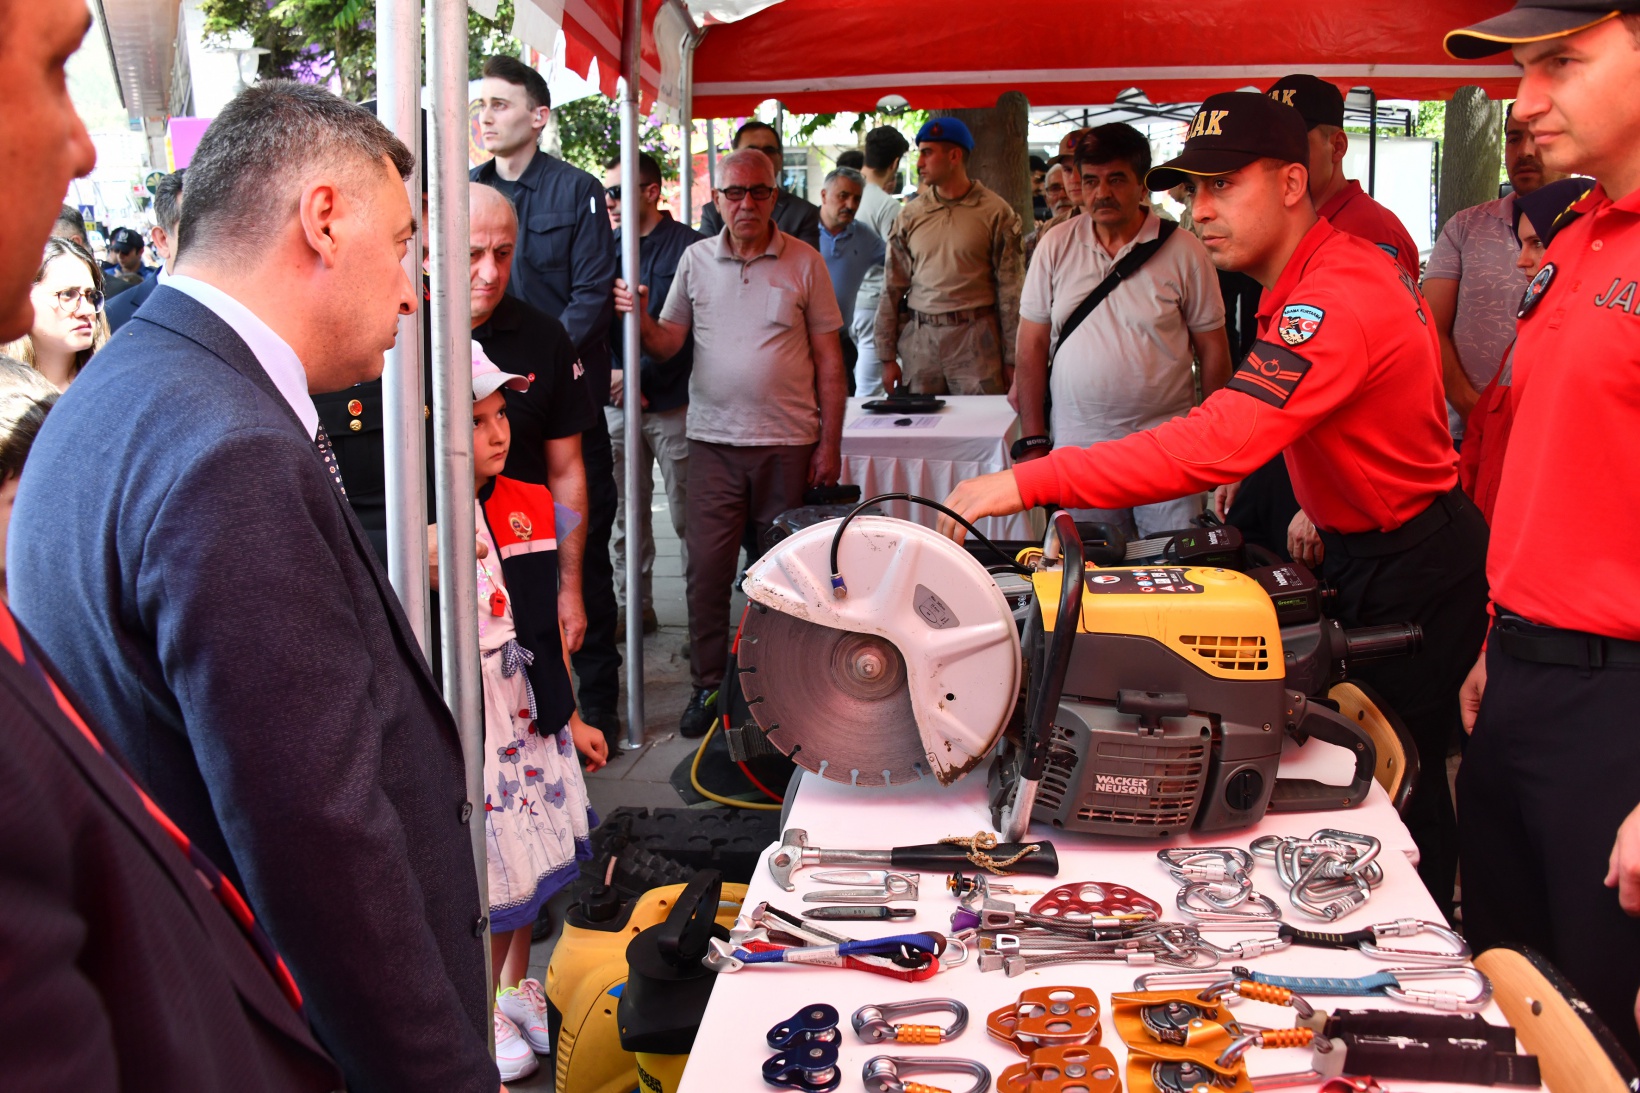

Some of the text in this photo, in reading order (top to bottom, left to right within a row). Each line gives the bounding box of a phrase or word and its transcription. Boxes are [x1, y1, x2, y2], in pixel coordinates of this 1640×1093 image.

[1594, 277, 1640, 316] JA
[1096, 774, 1148, 787] WACKER
[1095, 783, 1147, 795] NEUSON
